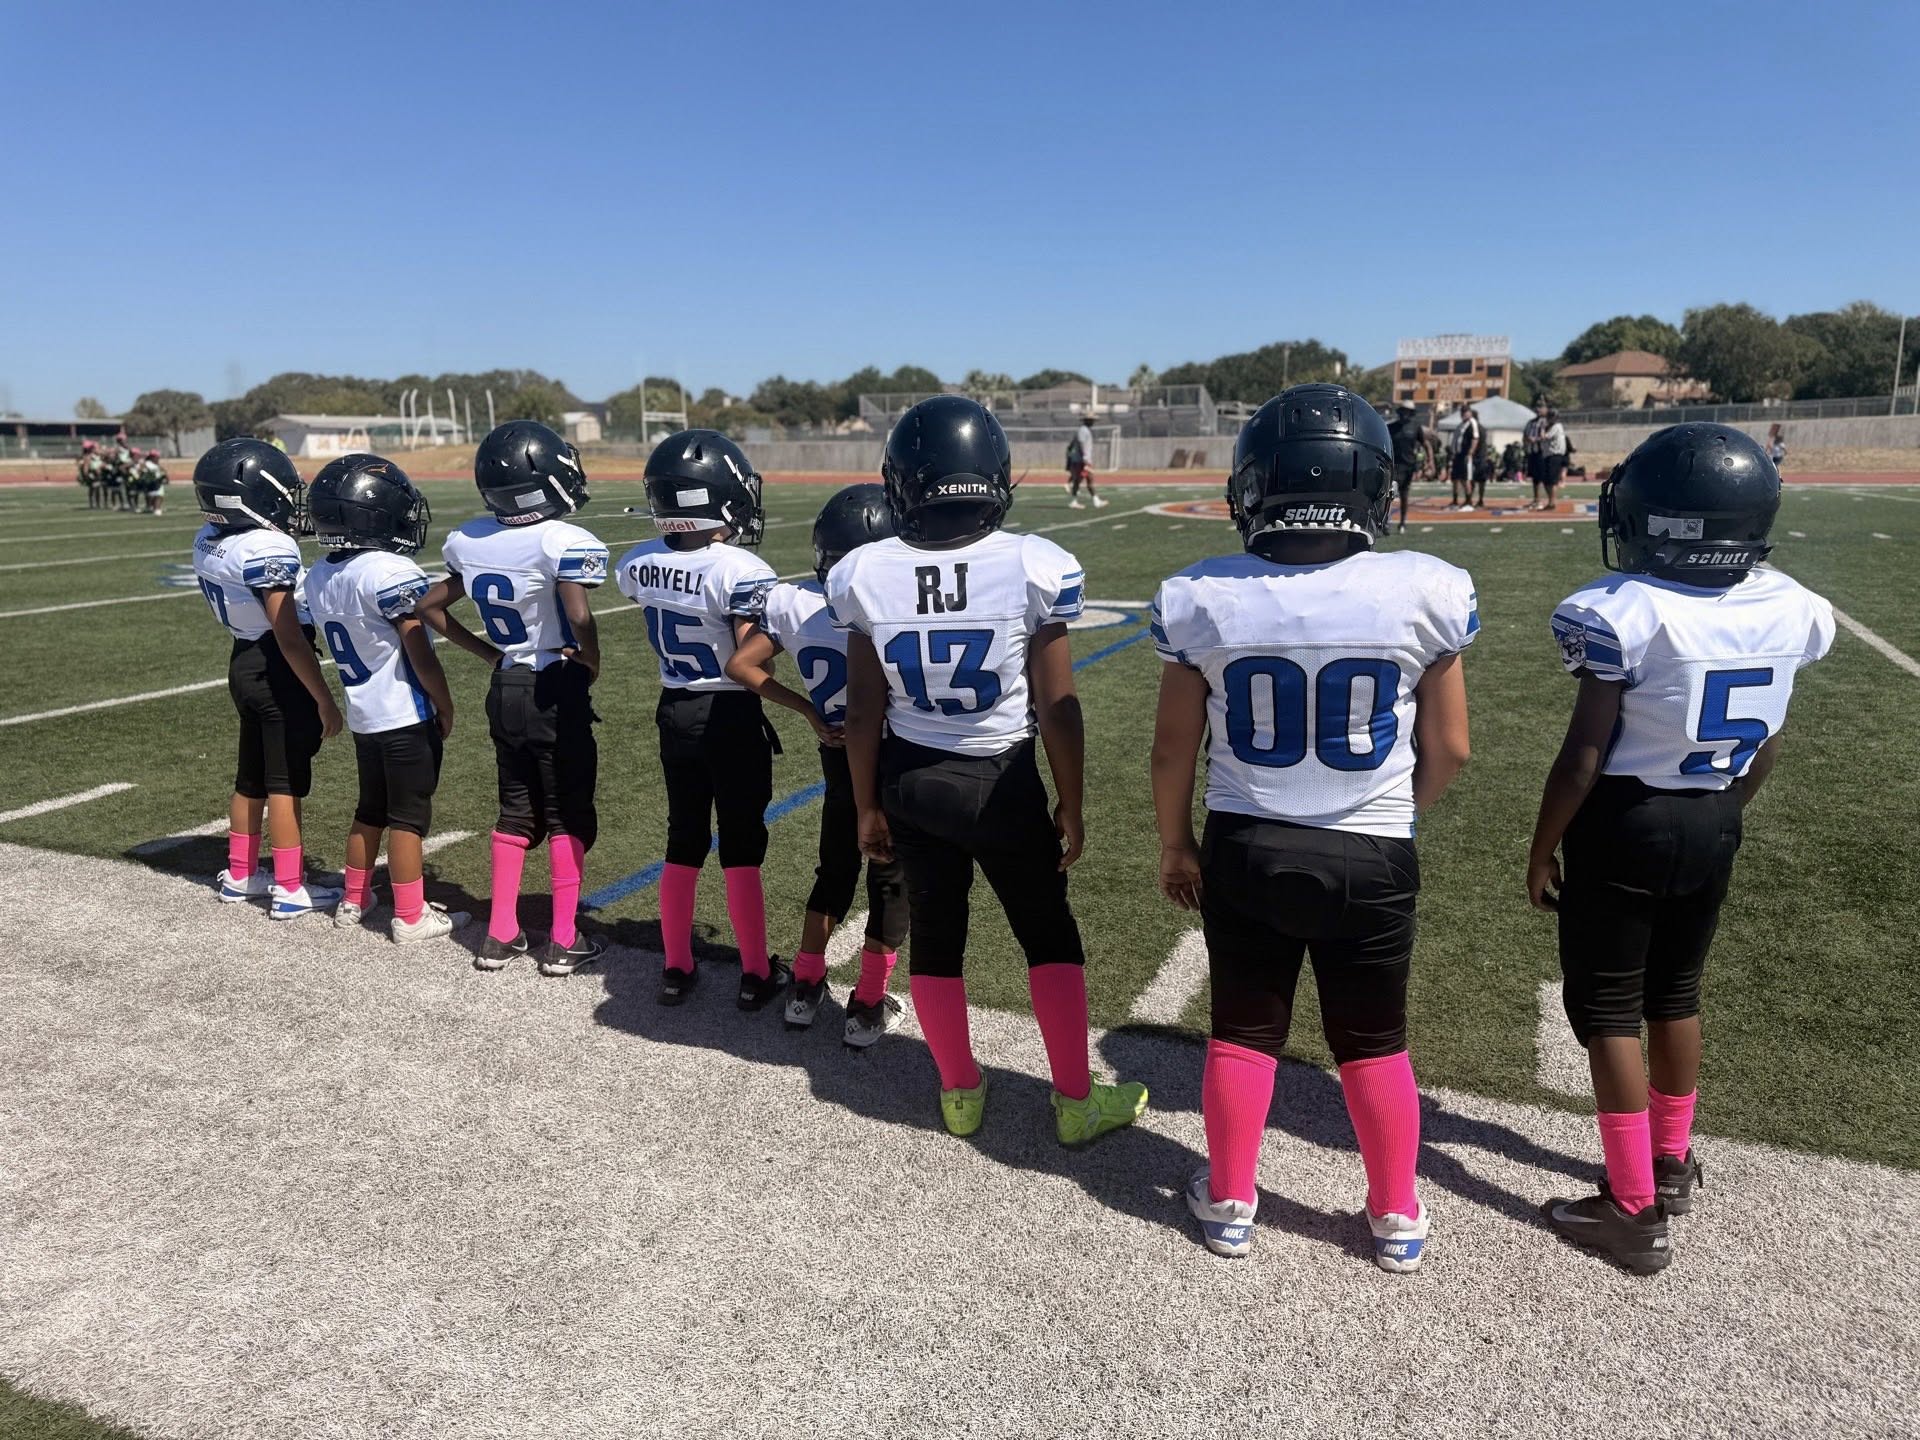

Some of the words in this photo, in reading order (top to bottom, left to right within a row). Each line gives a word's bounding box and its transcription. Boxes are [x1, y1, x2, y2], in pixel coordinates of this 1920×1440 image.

[937, 483, 988, 496] XENITH
[1283, 504, 1346, 521] schutt
[1687, 551, 1749, 565] schutt
[472, 573, 528, 644] 6
[914, 562, 969, 615] RJ
[324, 620, 373, 687] 9
[643, 605, 722, 681] 15
[884, 629, 1003, 717] 13
[1222, 655, 1402, 772] 00
[1679, 667, 1774, 776] 5
[1221, 1227, 1247, 1240] NIKE
[1383, 1243, 1409, 1256] NIKE
